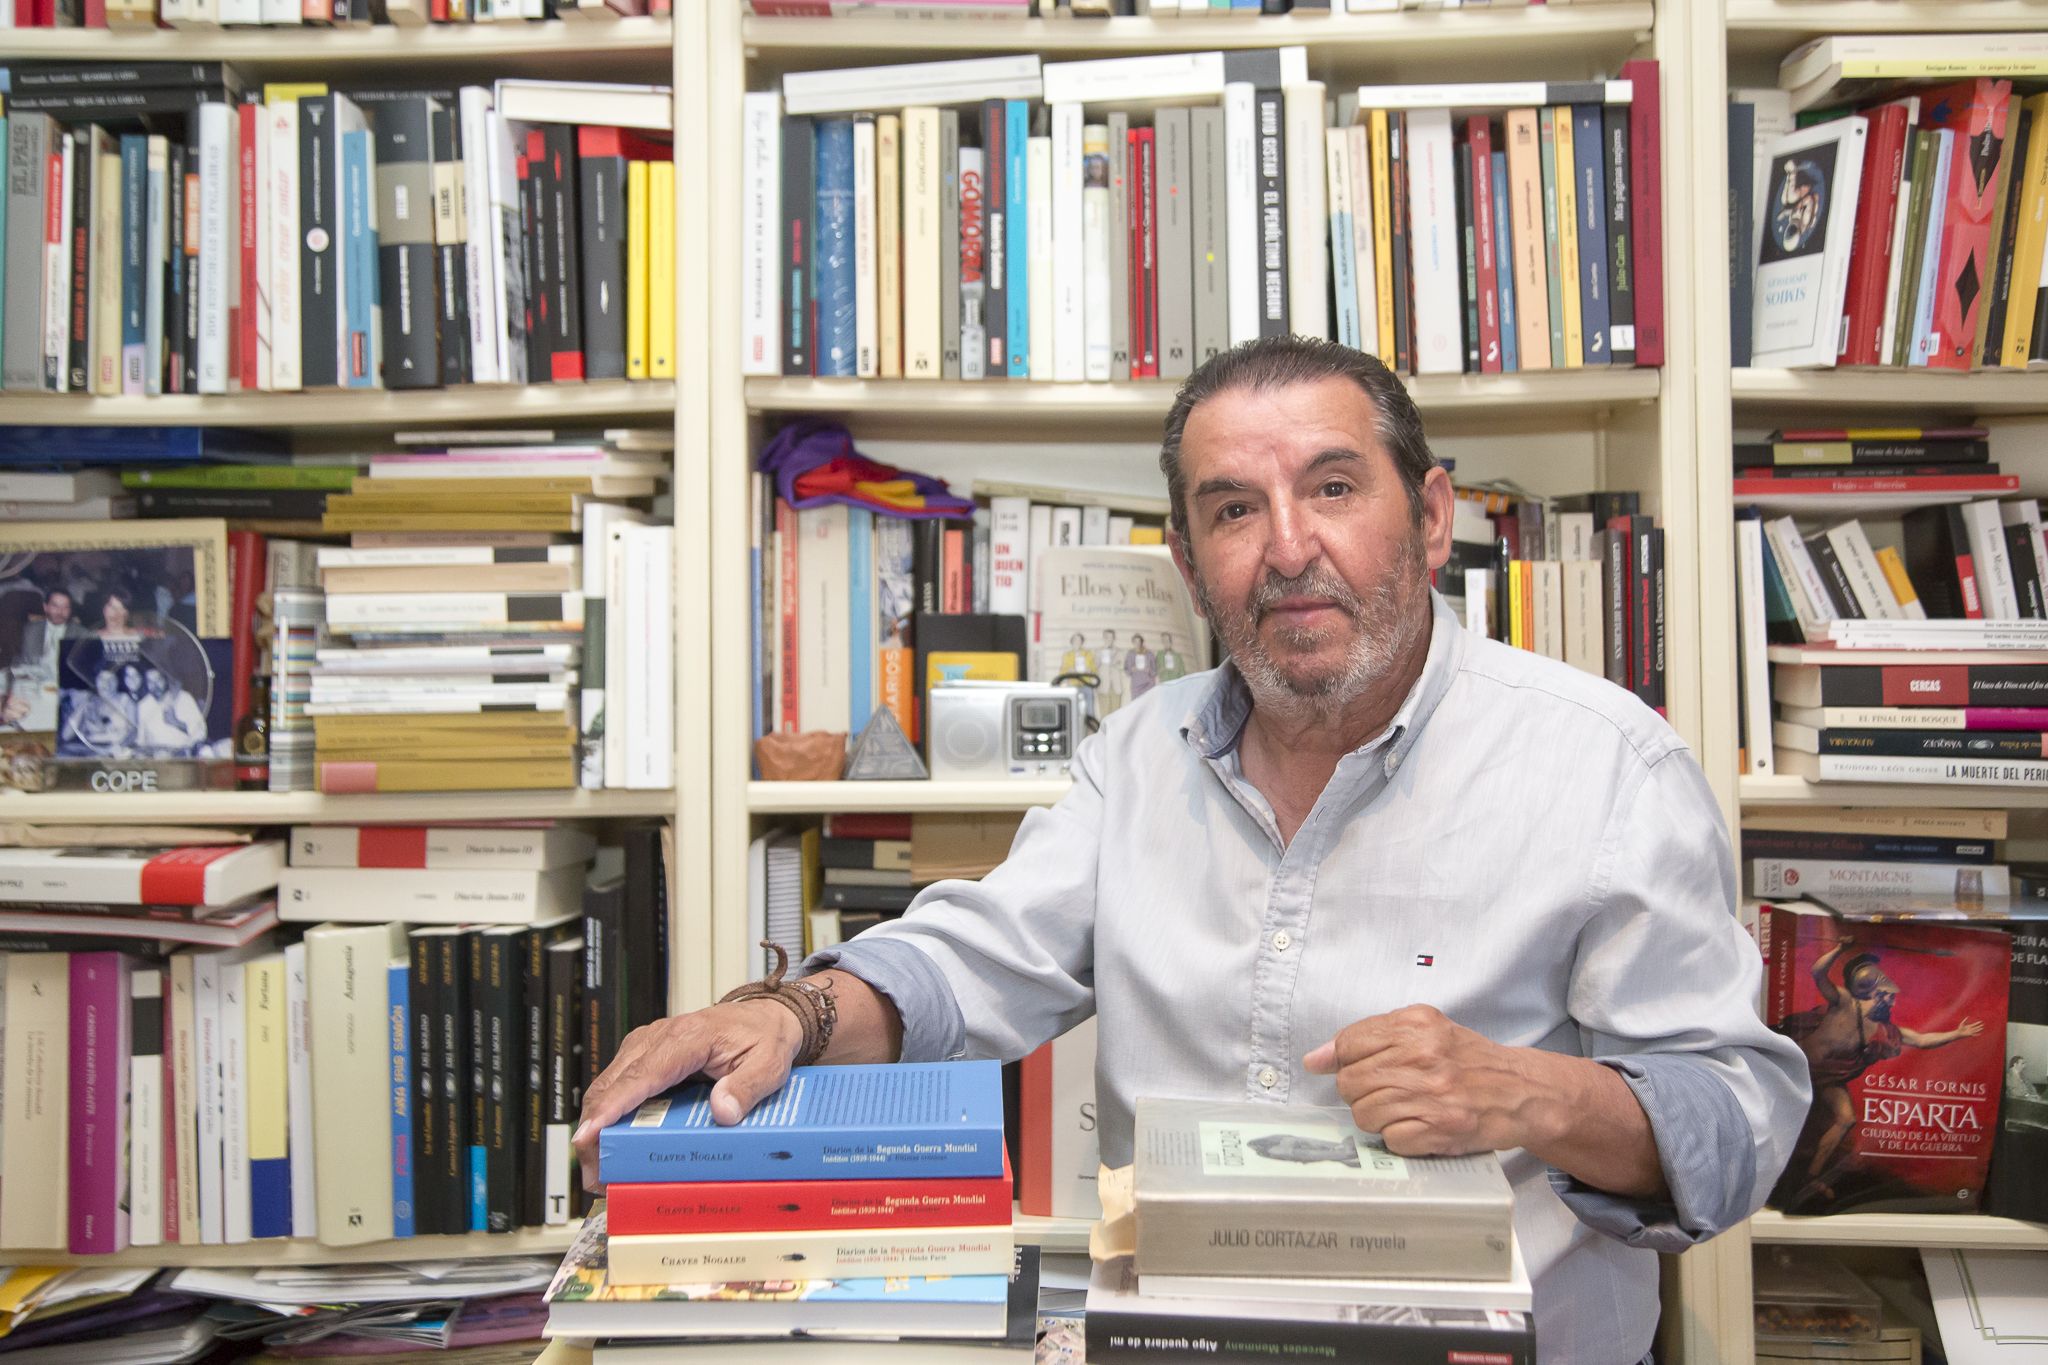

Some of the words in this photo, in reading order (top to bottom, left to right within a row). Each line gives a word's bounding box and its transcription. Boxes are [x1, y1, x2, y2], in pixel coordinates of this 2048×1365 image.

[1612, 128, 1624, 165] mejores
[1613, 168, 1626, 202] páginas
[1613, 204, 1624, 221] Mis
[960, 170, 983, 284] GOMORRA
[1615, 234, 1626, 268] Camba
[1616, 270, 1628, 291] Julio
[995, 544, 1010, 554] UN
[995, 560, 1023, 571] BUEN
[1060, 574, 1112, 597] Ellos
[1118, 583, 1129, 603] y
[1136, 579, 1173, 603] ellas
[1910, 680, 1941, 692] CERCAS
[1872, 715, 1898, 723] FINAL
[1921, 716, 1958, 724] BOSQUE
[1946, 765, 1957, 778] LA
[1961, 766, 1999, 779] MUERTE
[2003, 767, 2020, 780] DEL
[90, 770, 158, 793] COPE
[1828, 869, 1913, 883] MONTAIGNE
[1865, 1073, 1918, 1090] CÉSAR
[1926, 1080, 1986, 1095] FORNIS
[394, 1087, 406, 1116] ANA
[1861, 1127, 1906, 1139] CIUDAD
[1908, 1130, 1922, 1141] DE
[1925, 1132, 1939, 1142] LA
[1940, 1133, 1981, 1143] VIRTUD
[823, 1146, 853, 1155] Diarios
[855, 1146, 866, 1154] de
[866, 1145, 874, 1153] la
[876, 1144, 911, 1155] Segunda
[914, 1144, 942, 1153] Guerra
[945, 1144, 977, 1152] Mundial
[1879, 1139, 1886, 1149] Y
[1887, 1141, 1901, 1150] DE
[1905, 1141, 1917, 1150] LA
[1919, 1142, 1962, 1152] GUERRA
[649, 1152, 686, 1162] CHAVES
[690, 1152, 733, 1161] NOGALES
[822, 1155, 848, 1163] Inéditos
[885, 1195, 920, 1207] Segunda
[922, 1196, 950, 1204] Guerra
[953, 1195, 986, 1204] Mundial
[831, 1207, 857, 1215] Inéditos
[1208, 1229, 1251, 1248] JULIO
[1254, 1230, 1339, 1250] CORTAZAR
[1349, 1235, 1407, 1253] rayuela
[890, 1247, 925, 1257] Segunda
[928, 1245, 956, 1254] Guerra
[958, 1244, 991, 1252] Mundial
[661, 1256, 698, 1266] CHAVES
[703, 1255, 746, 1264] NOGALES
[1128, 1336, 1142, 1350] de
[1144, 1337, 1189, 1351] quedará
[1192, 1339, 1217, 1353] Algo
[1225, 1340, 1280, 1354] Monmany
[1282, 1345, 1336, 1357] Mercedes
